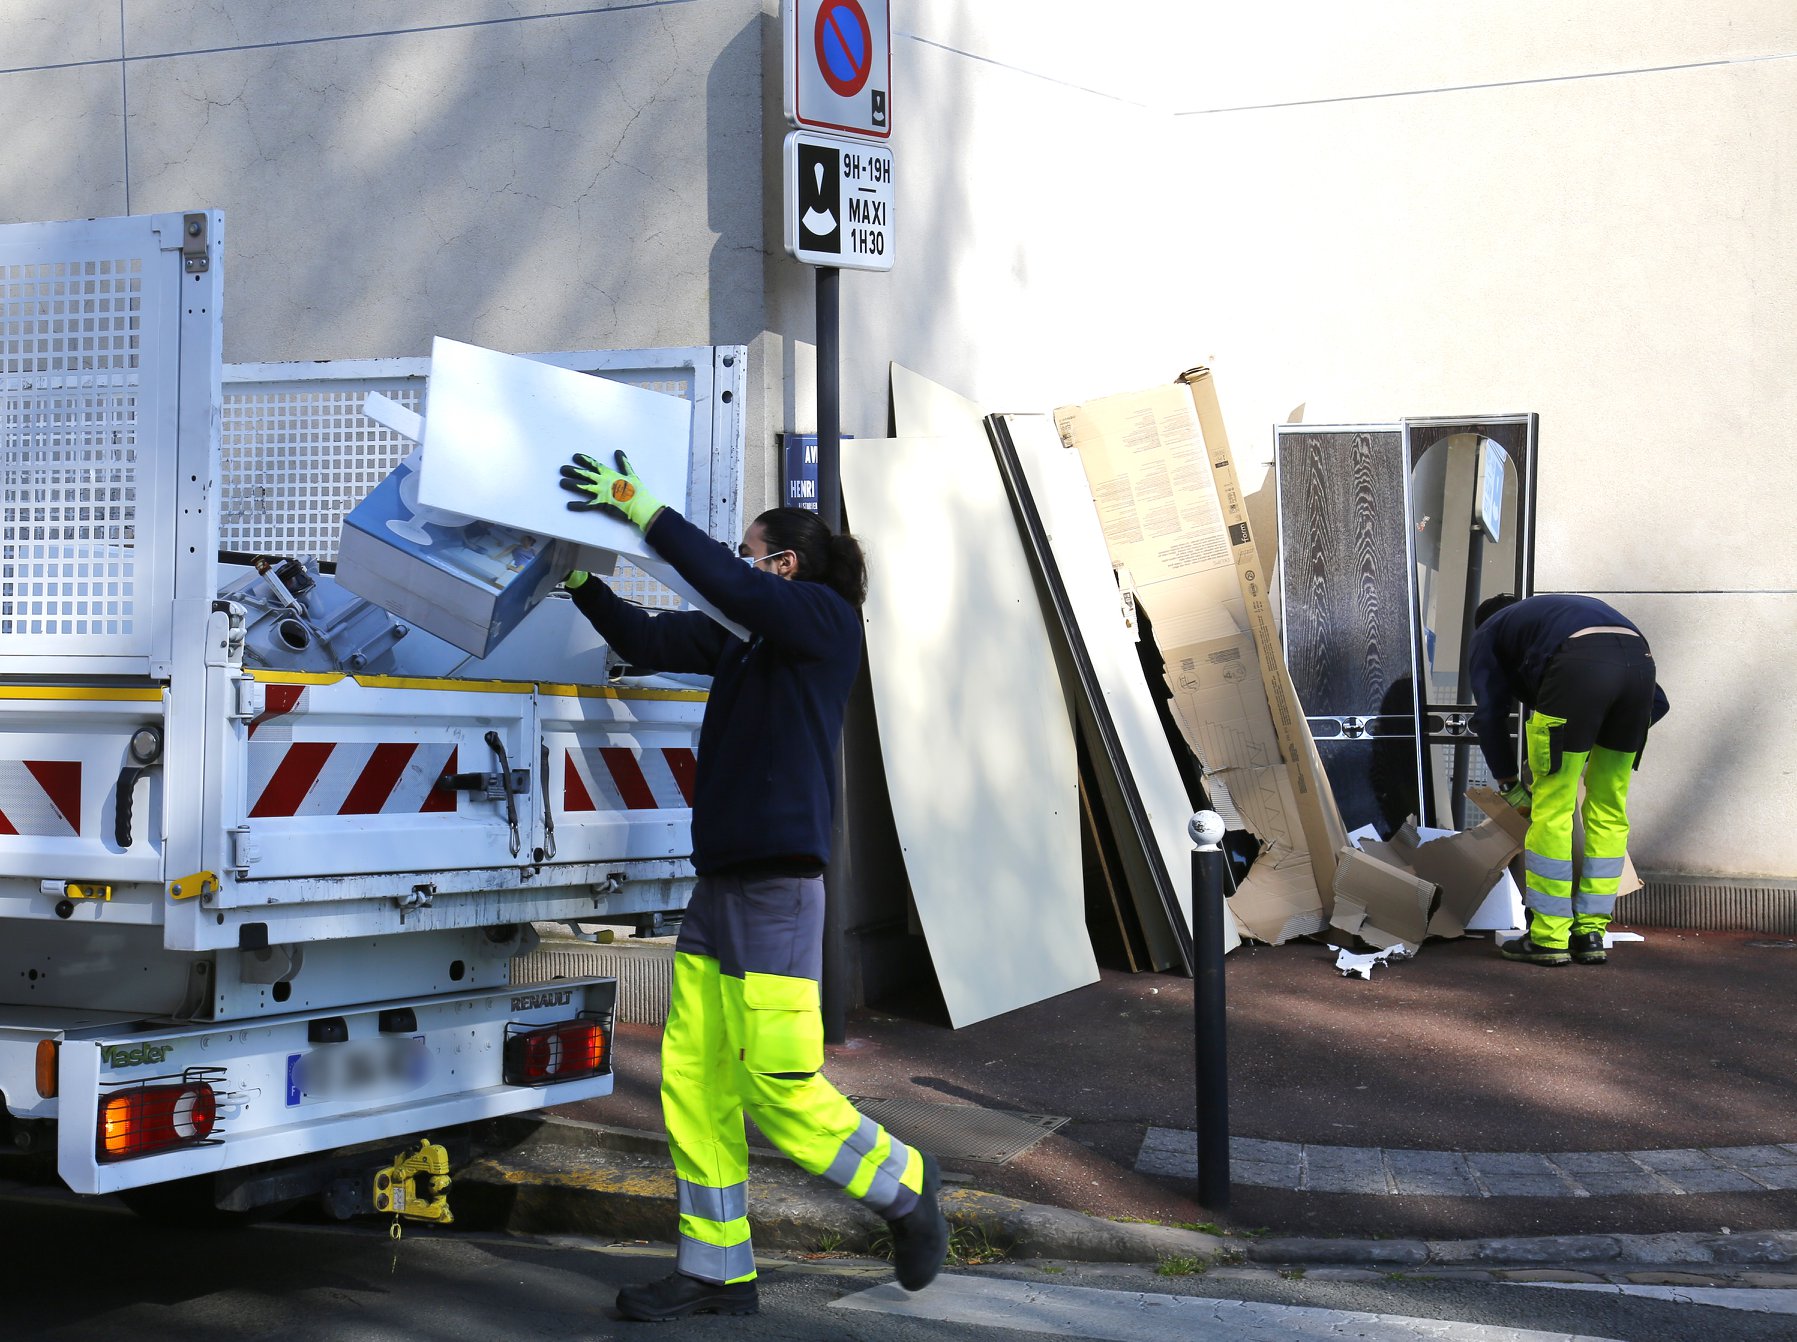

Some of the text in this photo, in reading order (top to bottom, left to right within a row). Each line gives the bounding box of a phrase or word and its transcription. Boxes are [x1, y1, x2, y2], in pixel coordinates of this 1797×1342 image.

[843, 153, 890, 184] 9H-19H
[849, 198, 886, 226] MAXI
[851, 228, 884, 255] 1H30
[804, 446, 818, 464] AV
[790, 480, 815, 498] HENRI
[1240, 523, 1250, 543] form
[511, 991, 573, 1012] RENAULT
[101, 1042, 174, 1069] Master
[291, 1085, 296, 1097] F
